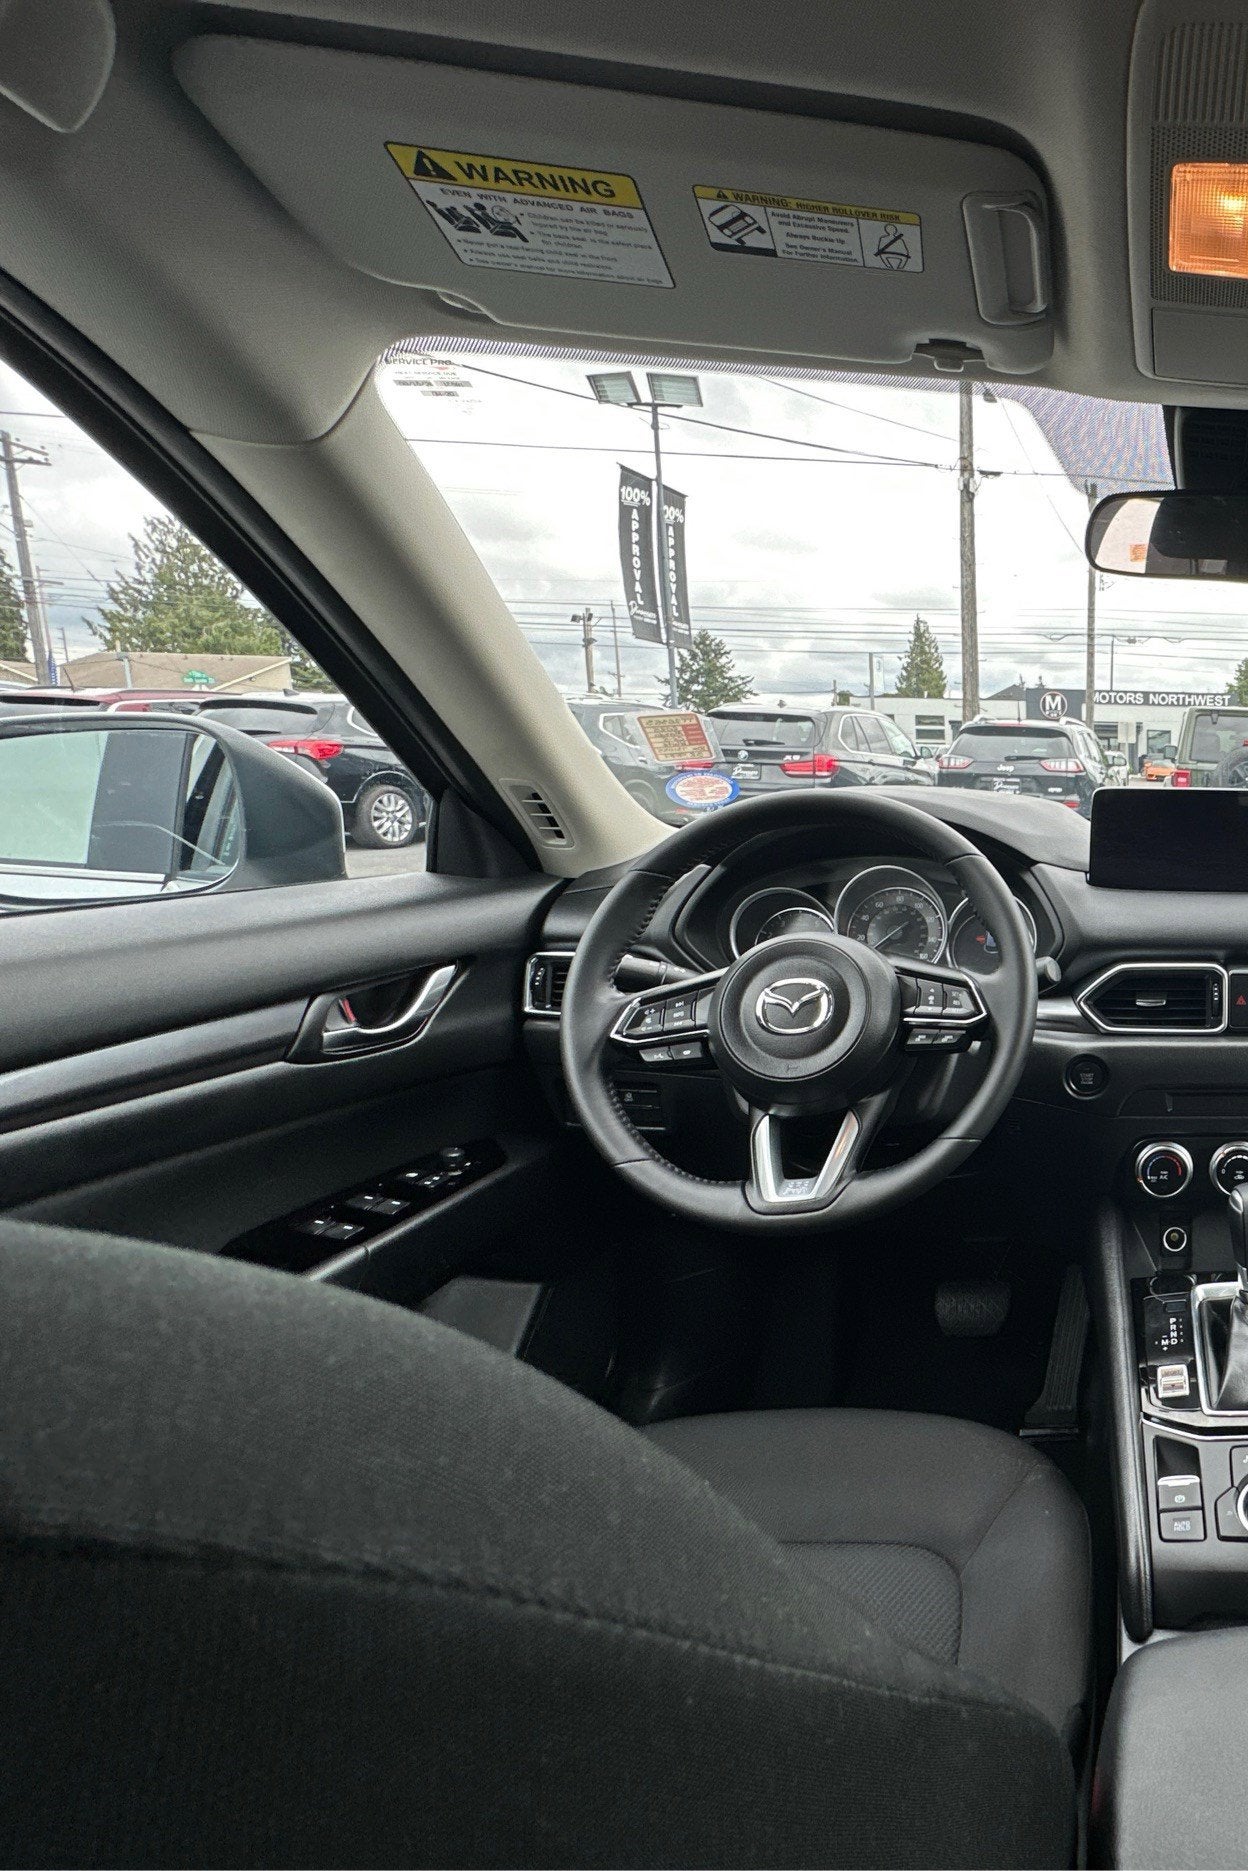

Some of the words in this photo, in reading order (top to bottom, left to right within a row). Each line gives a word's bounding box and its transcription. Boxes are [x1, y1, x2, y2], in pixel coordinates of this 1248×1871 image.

[455, 160, 616, 199] WARNING
[440, 188, 471, 199] EVEN
[477, 192, 506, 204] WITH
[513, 197, 573, 212] ADVANCED
[580, 206, 597, 214] AIR
[603, 208, 634, 219] BAGS
[732, 192, 791, 209] WARNING:
[796, 202, 830, 214] HIGHER
[832, 207, 878, 219] ROLLOVER
[880, 213, 901, 221] RISK
[772, 211, 790, 219] Avoid
[620, 486, 651, 506] 100%
[664, 505, 684, 524] 00%
[631, 508, 644, 606] APPROVAL
[668, 525, 679, 617] APPROVAL
[1045, 695, 1062, 711] M
[1149, 693, 1231, 706] NORTHWEST
[997, 764, 1015, 772] Jeep
